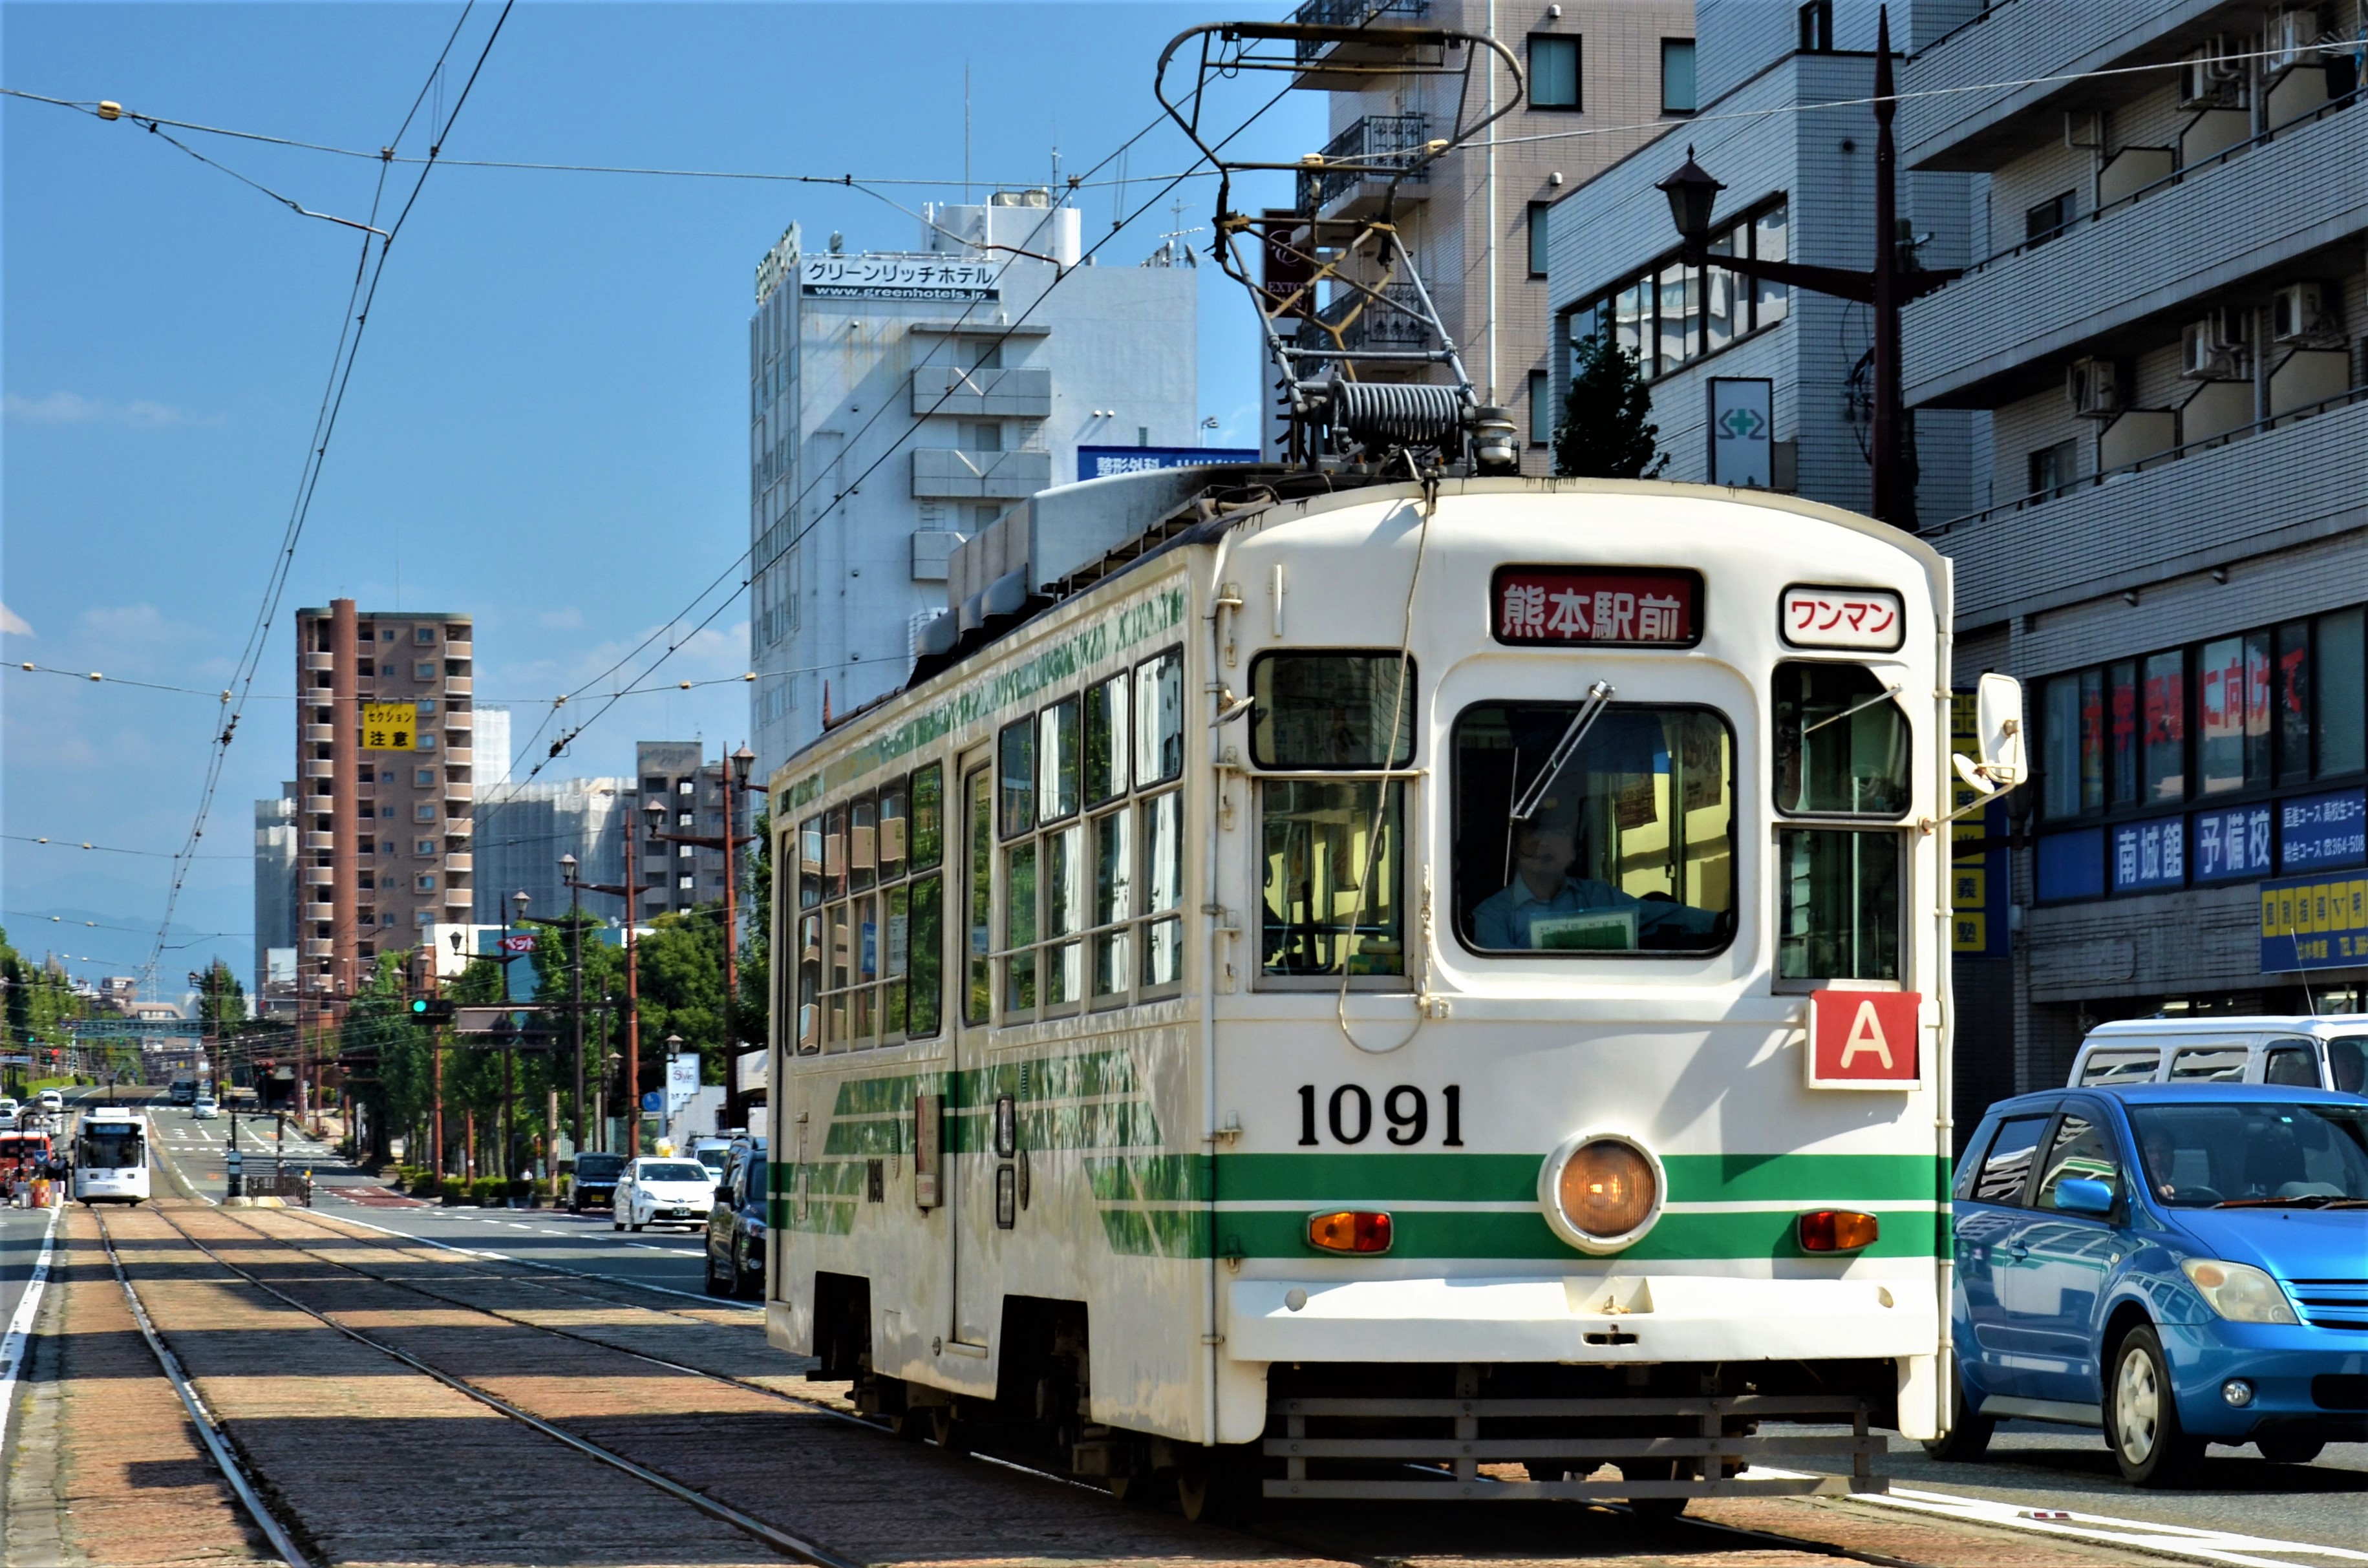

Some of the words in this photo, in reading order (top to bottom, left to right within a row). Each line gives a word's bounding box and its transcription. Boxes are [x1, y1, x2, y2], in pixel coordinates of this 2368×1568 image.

[809, 262, 992, 284] グリーンリッチホテル
[1268, 281, 1312, 292] EXTO
[814, 285, 988, 300] www.greenhotels.jp
[1501, 584, 1681, 640] 熊本駅前
[1791, 600, 1894, 633] ワンマン
[368, 711, 412, 723] セクション
[370, 730, 409, 747] 注意
[2118, 822, 2183, 884] 南城館
[2201, 809, 2270, 873] 予備校
[1840, 999, 1894, 1070] A
[1297, 1083, 1464, 1146] 1091
